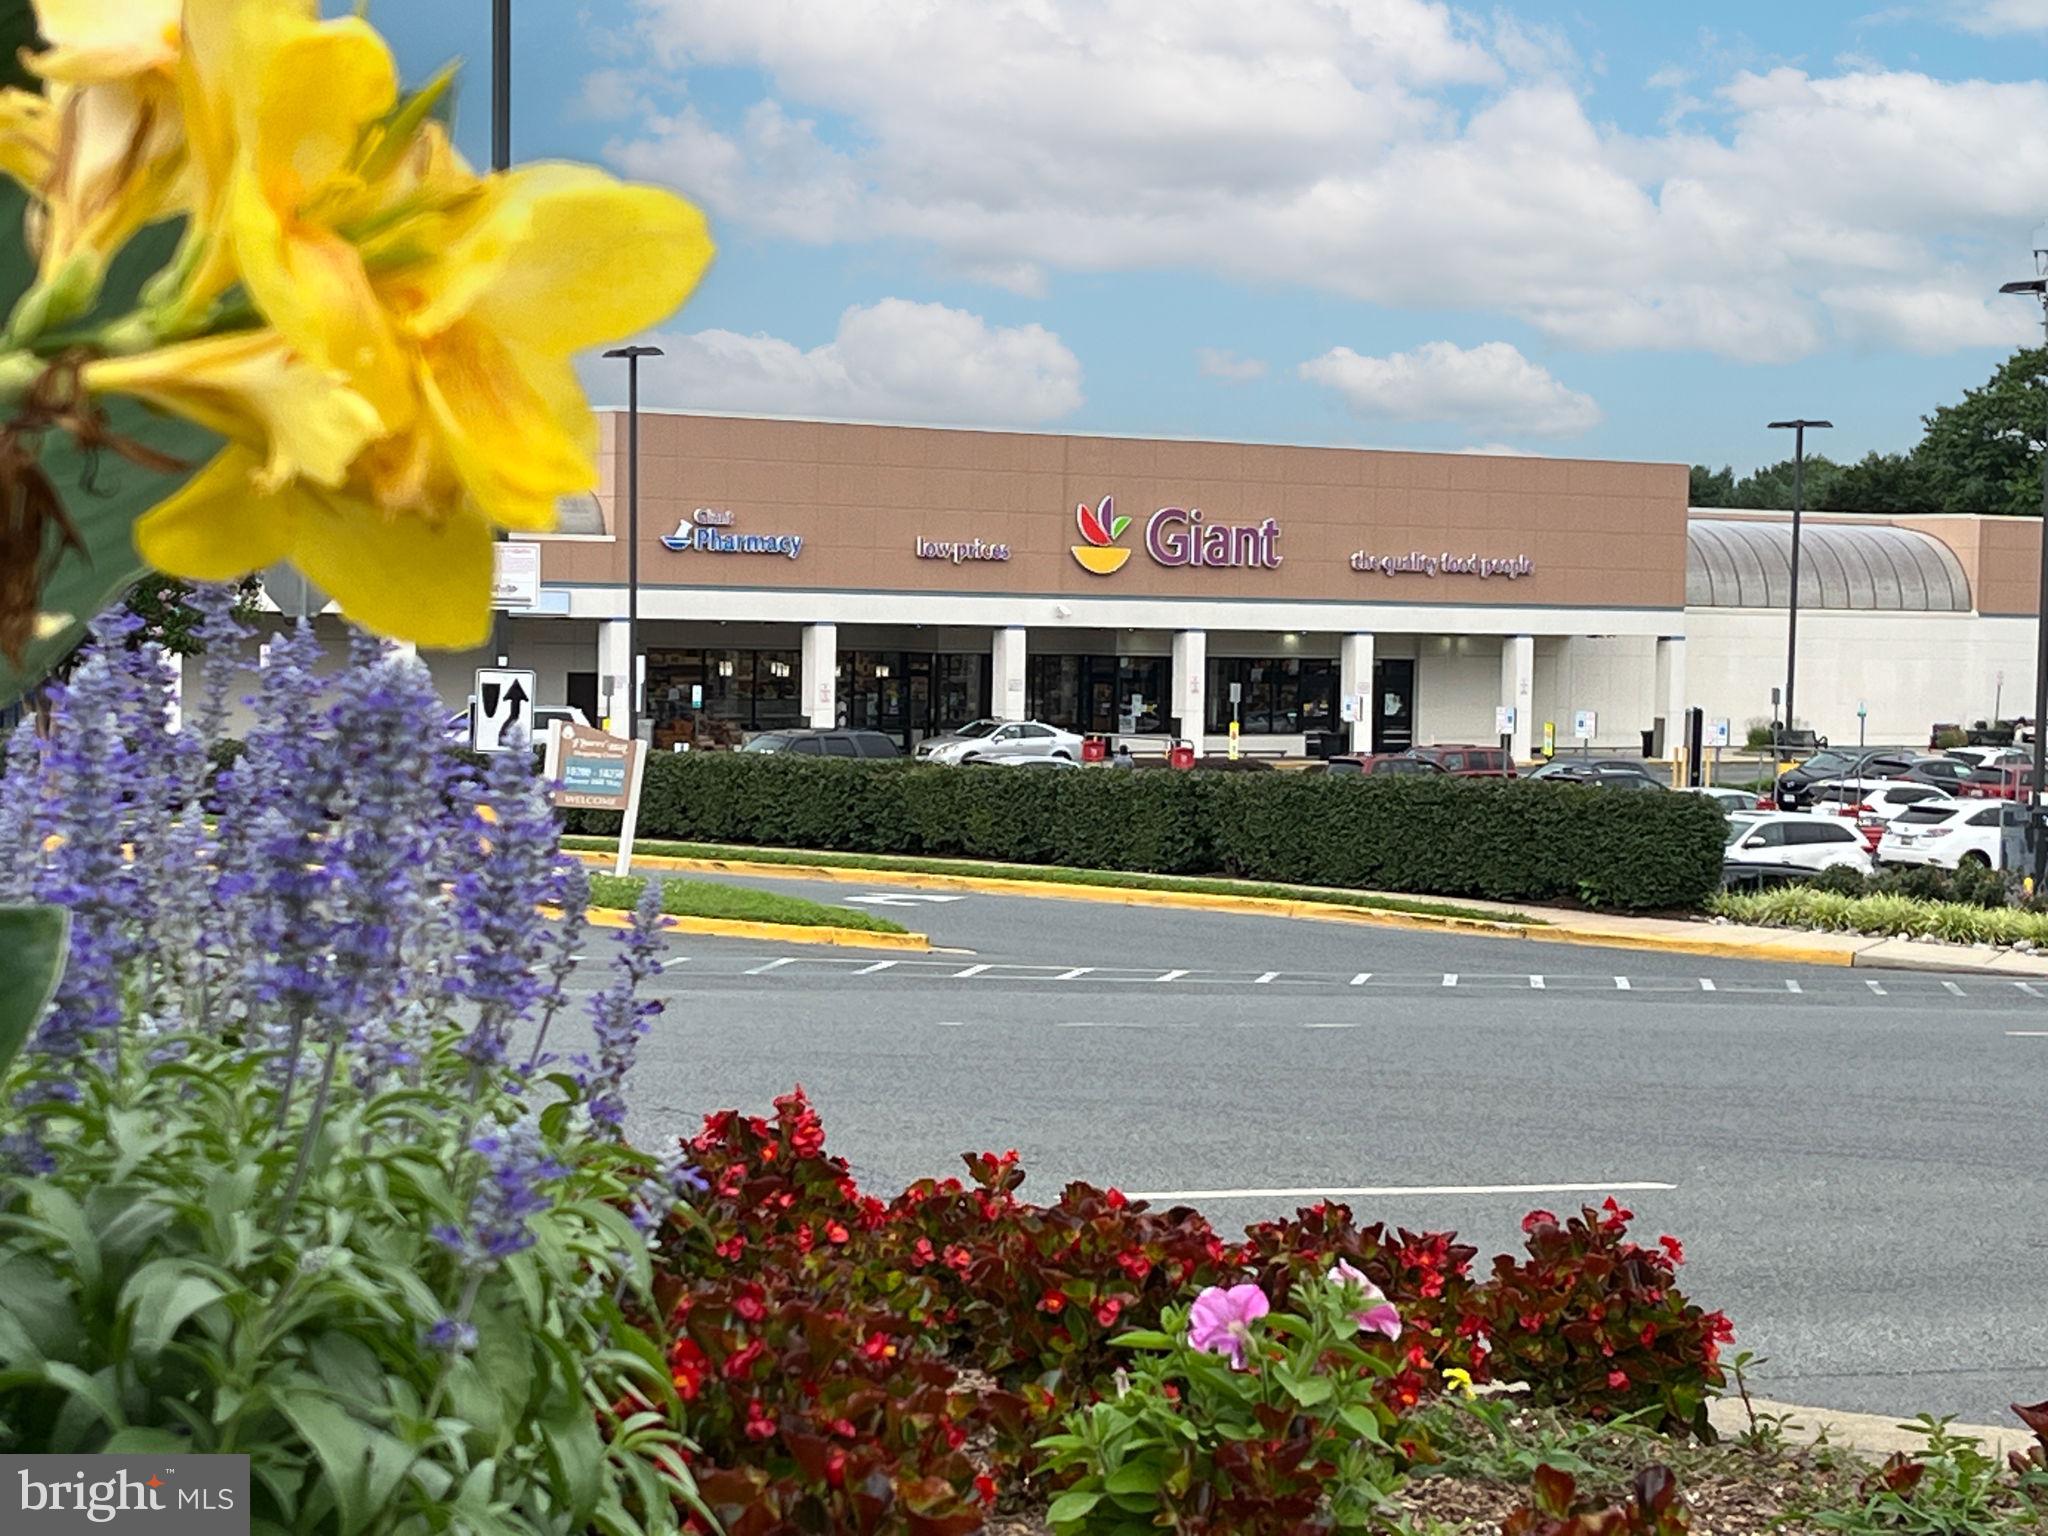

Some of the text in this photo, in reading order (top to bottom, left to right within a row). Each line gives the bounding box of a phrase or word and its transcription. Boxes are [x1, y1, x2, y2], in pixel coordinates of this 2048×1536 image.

[693, 527, 803, 559] Pharmacy
[916, 535, 1011, 565] low prices
[1146, 507, 1284, 568] Giant
[1351, 550, 1535, 580] the quality food people
[565, 795, 617, 805] WELCOME
